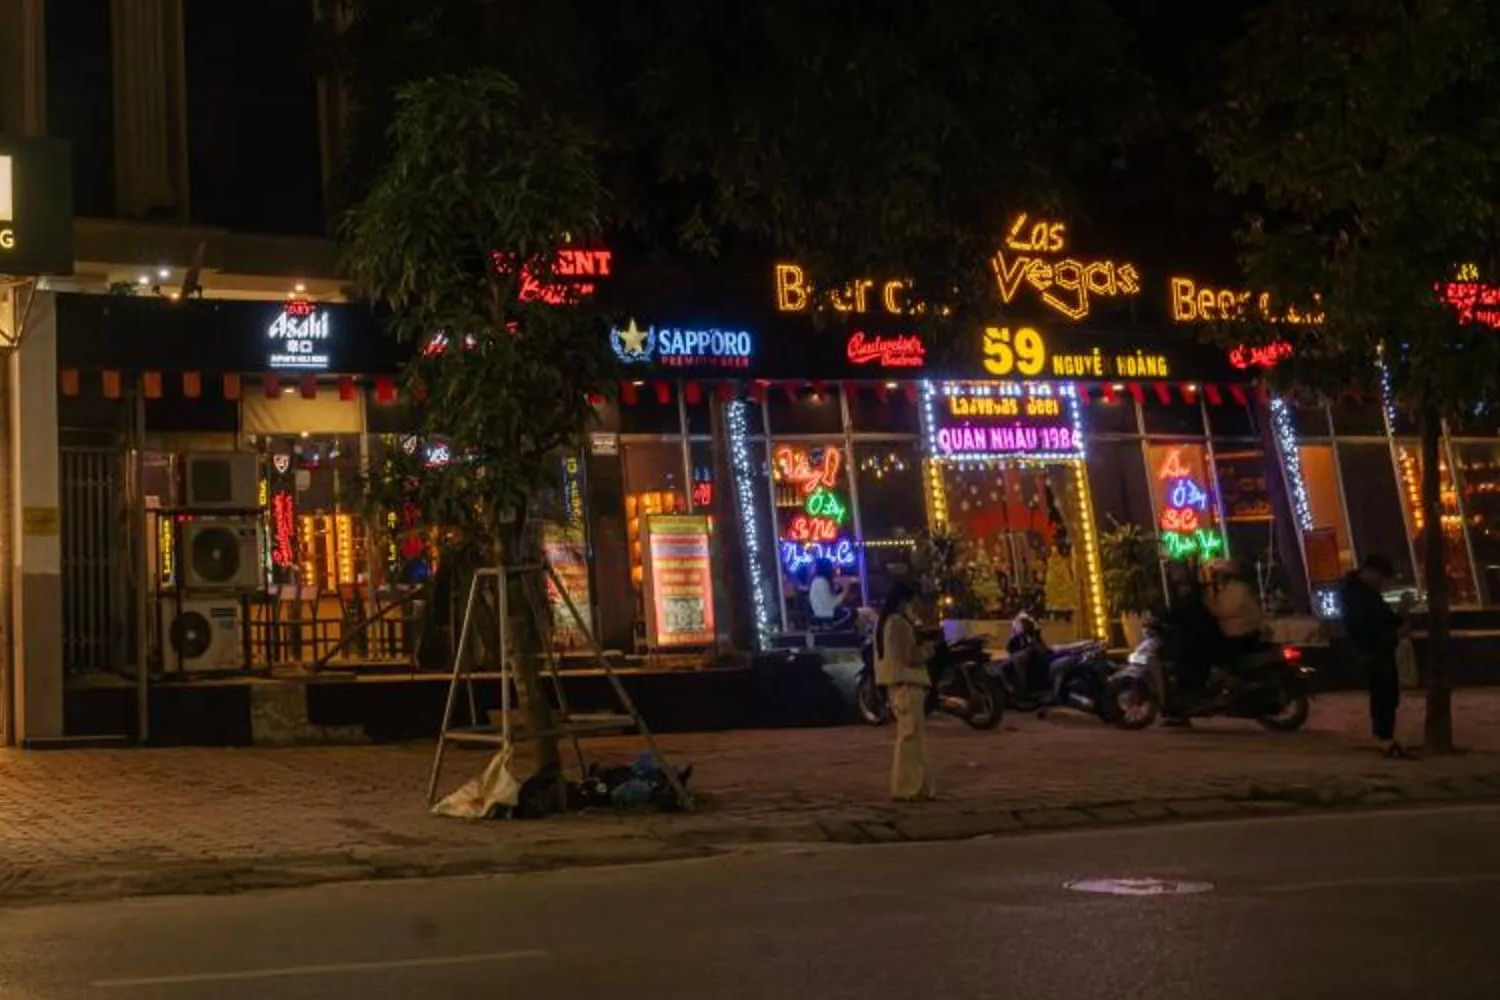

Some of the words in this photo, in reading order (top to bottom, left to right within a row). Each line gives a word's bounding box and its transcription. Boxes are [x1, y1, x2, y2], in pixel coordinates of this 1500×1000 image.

[1006, 212, 1065, 250] Las
[992, 250, 1140, 320] Vegas
[268, 311, 329, 339] Asahi
[658, 329, 751, 356] SAPPORO
[983, 327, 1046, 375] 59
